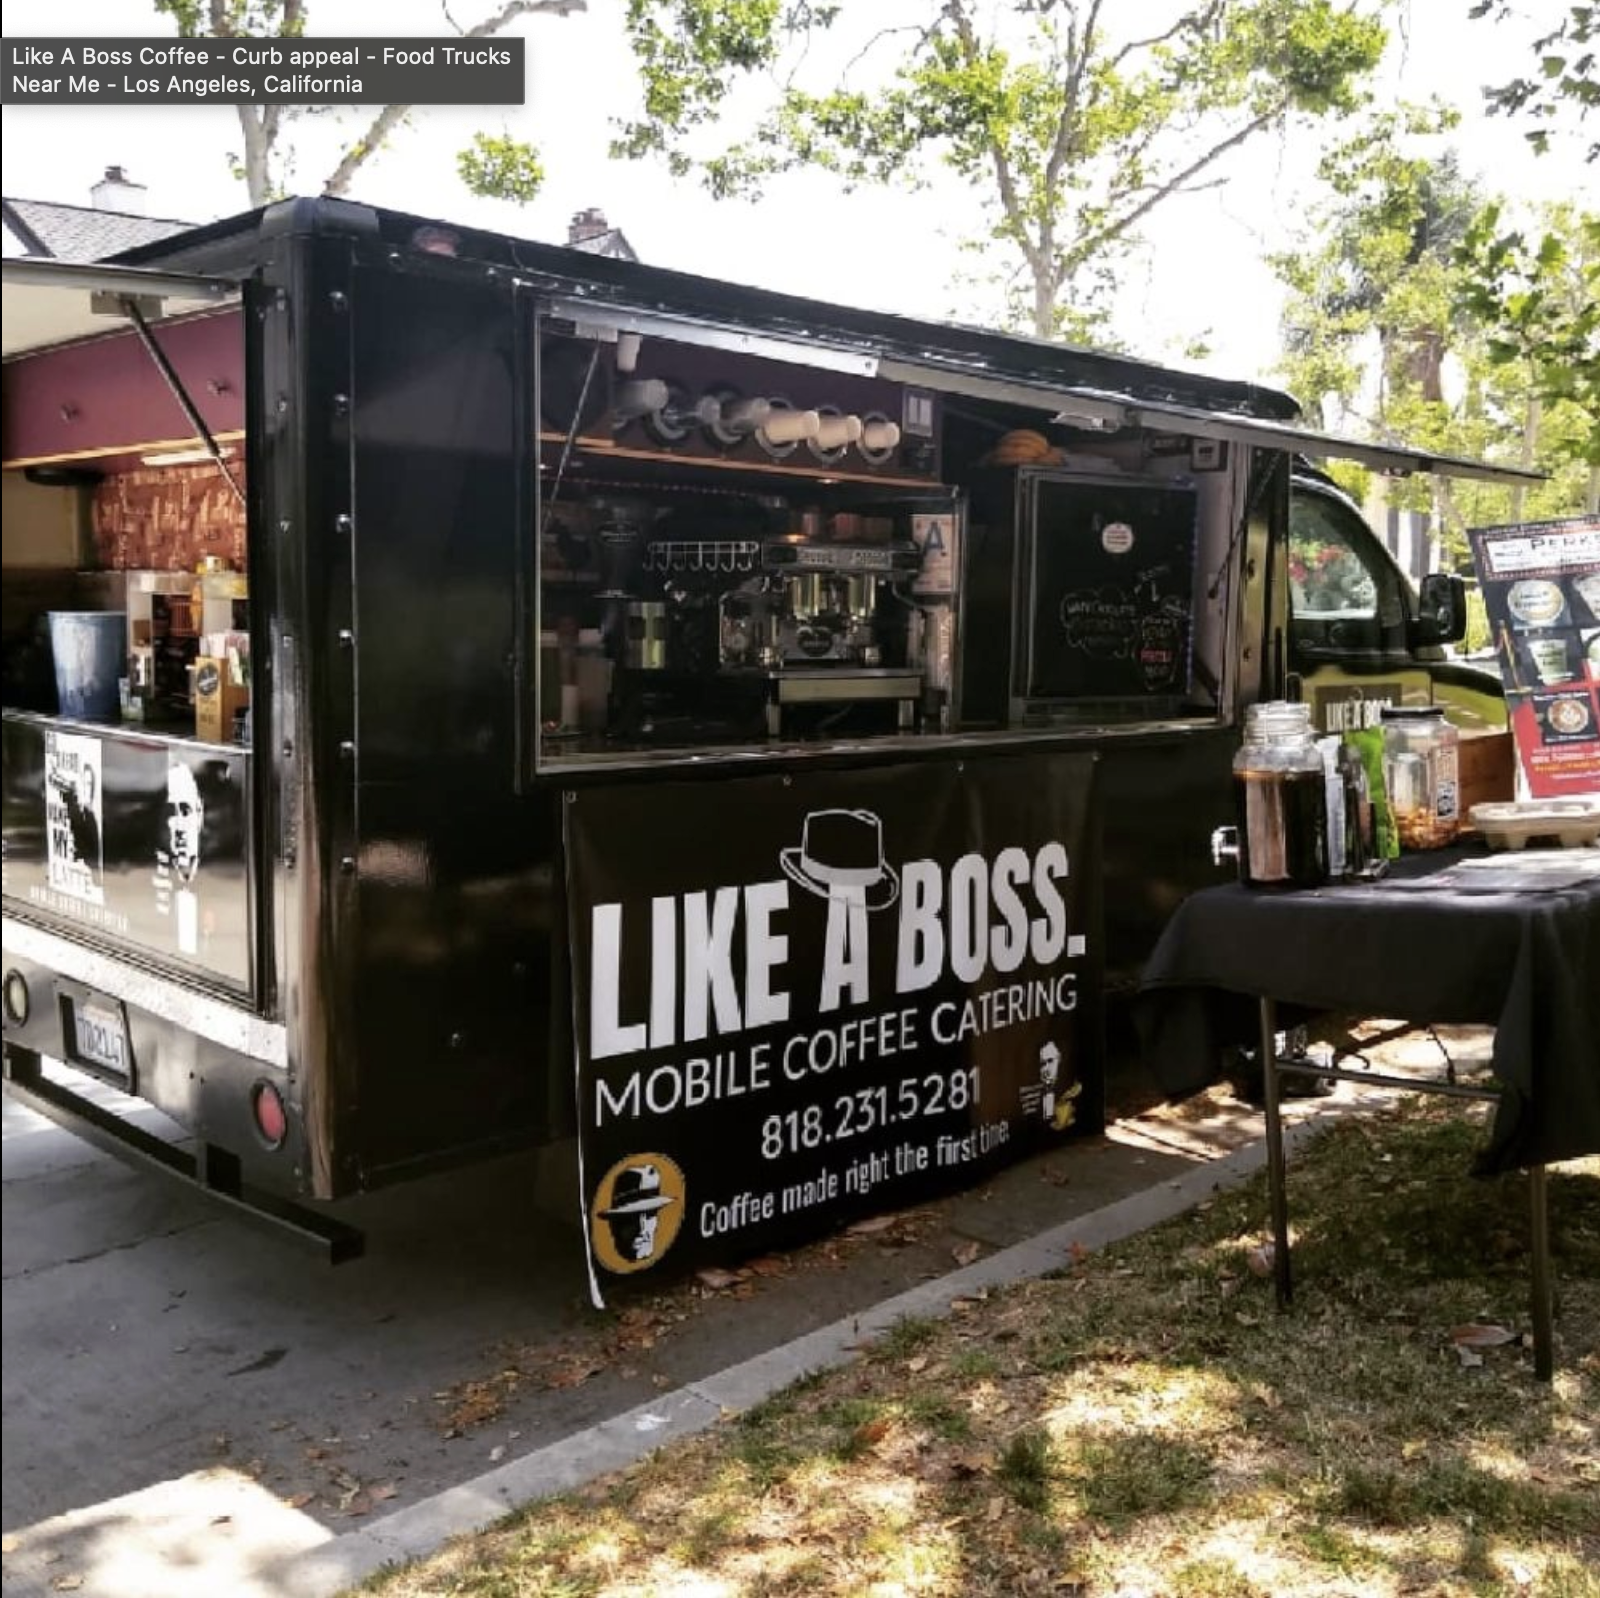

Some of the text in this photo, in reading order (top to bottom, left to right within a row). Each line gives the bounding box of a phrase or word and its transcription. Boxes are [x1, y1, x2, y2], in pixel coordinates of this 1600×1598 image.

[921, 519, 947, 557] A
[1326, 701, 1350, 732] LIKE
[590, 841, 1087, 1060] LIKE A BOSS.
[595, 973, 1077, 1127] MOBILE COFFEE CATERING
[761, 1066, 981, 1160] 818.231.5281
[700, 1192, 775, 1239] Coffee
[782, 1167, 839, 1215] made
[845, 1151, 892, 1194] right
[894, 1142, 929, 1176] the
[936, 1133, 979, 1167] first
